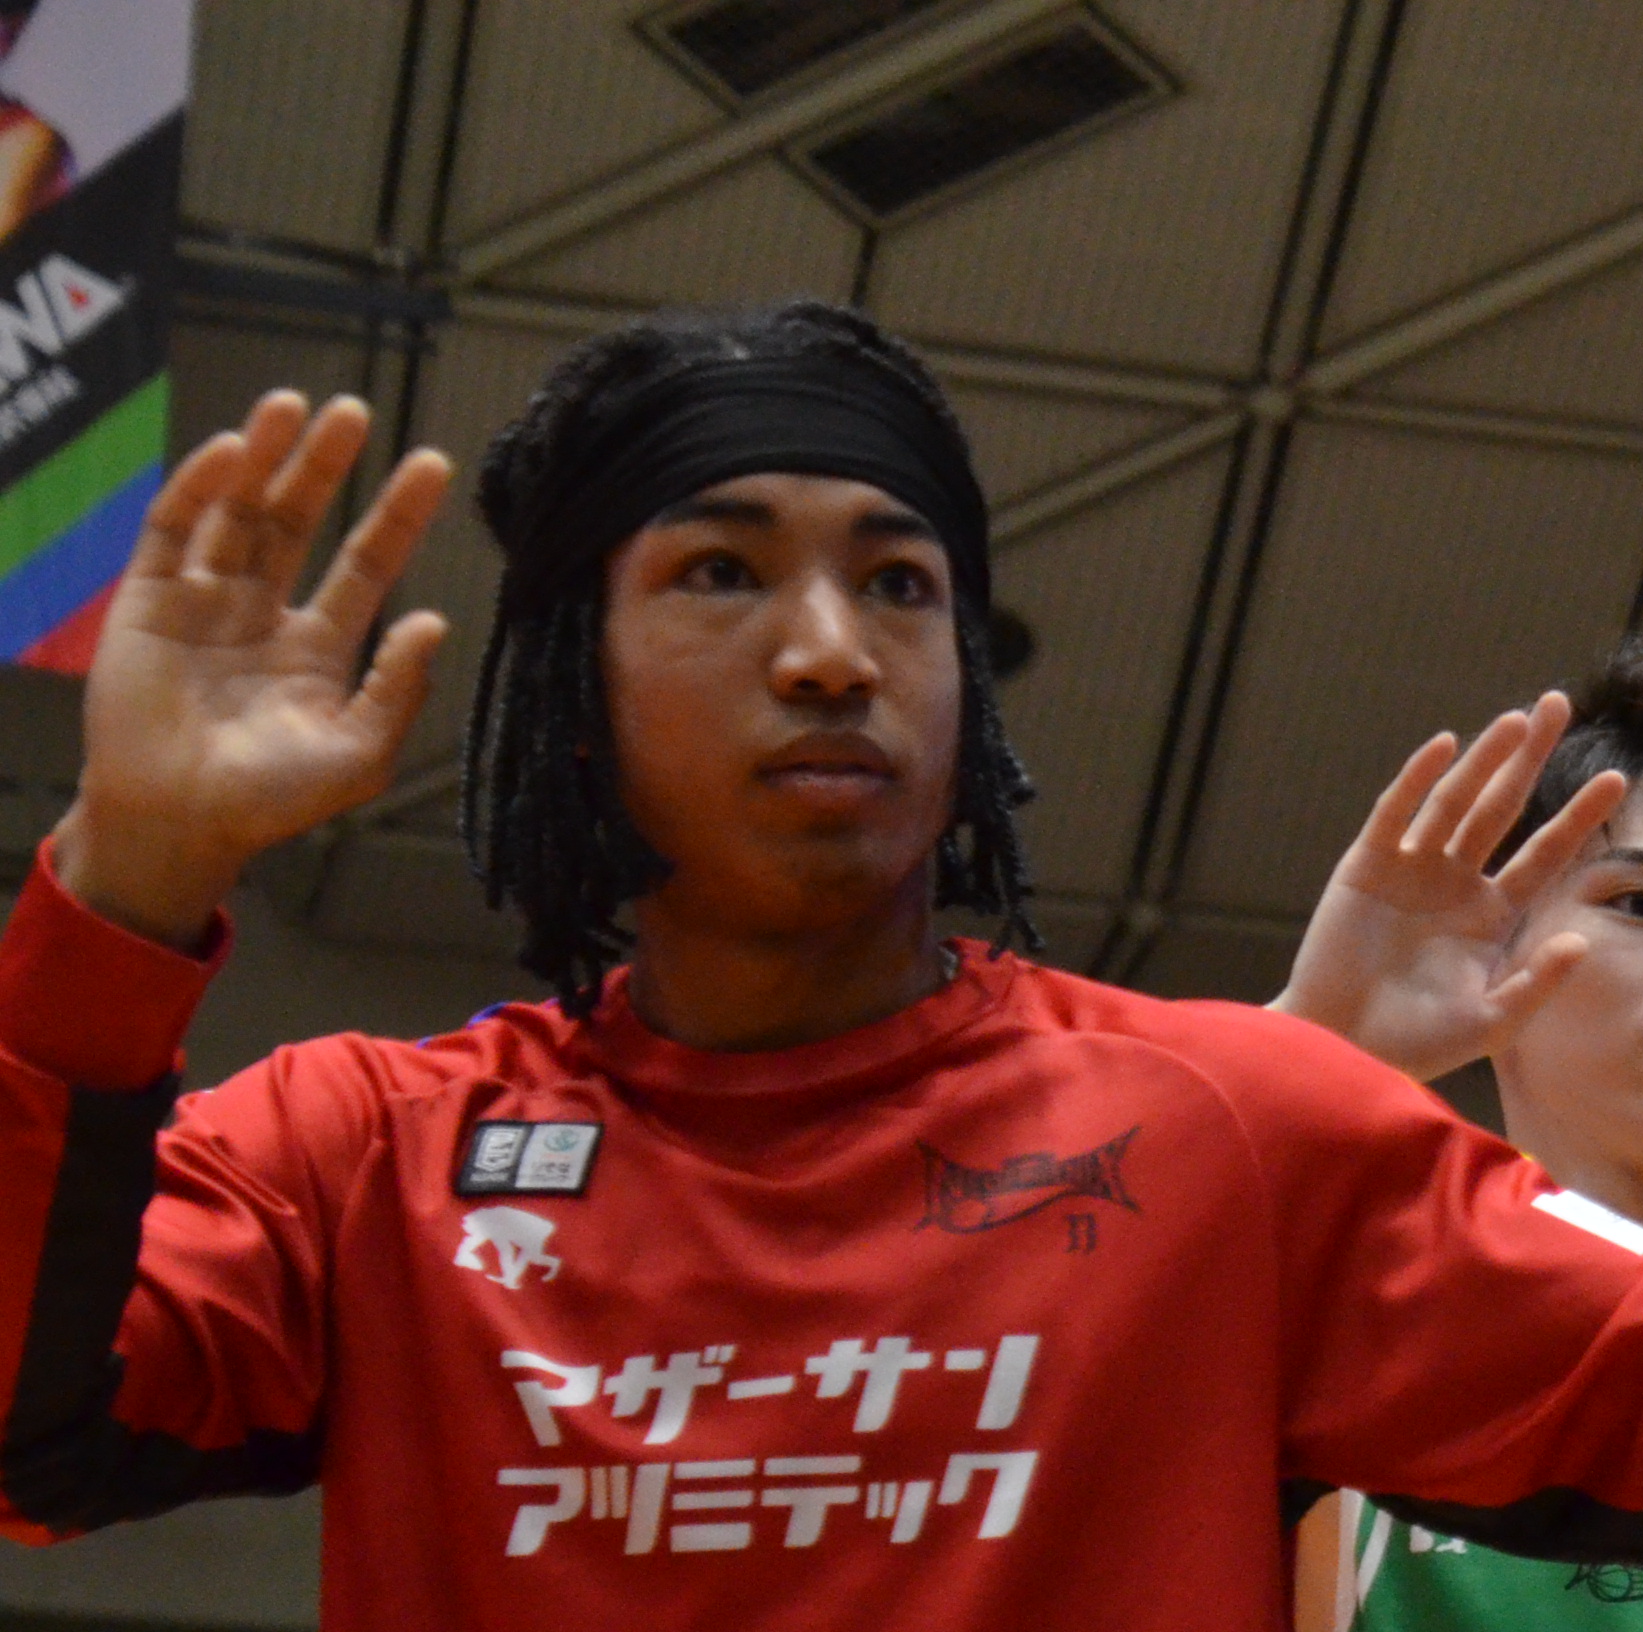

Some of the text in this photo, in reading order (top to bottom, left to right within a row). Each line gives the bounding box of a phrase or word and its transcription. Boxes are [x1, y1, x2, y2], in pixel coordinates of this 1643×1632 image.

[501, 1333, 1043, 1448] マザーサン
[497, 1449, 1041, 1558] アツミテック
